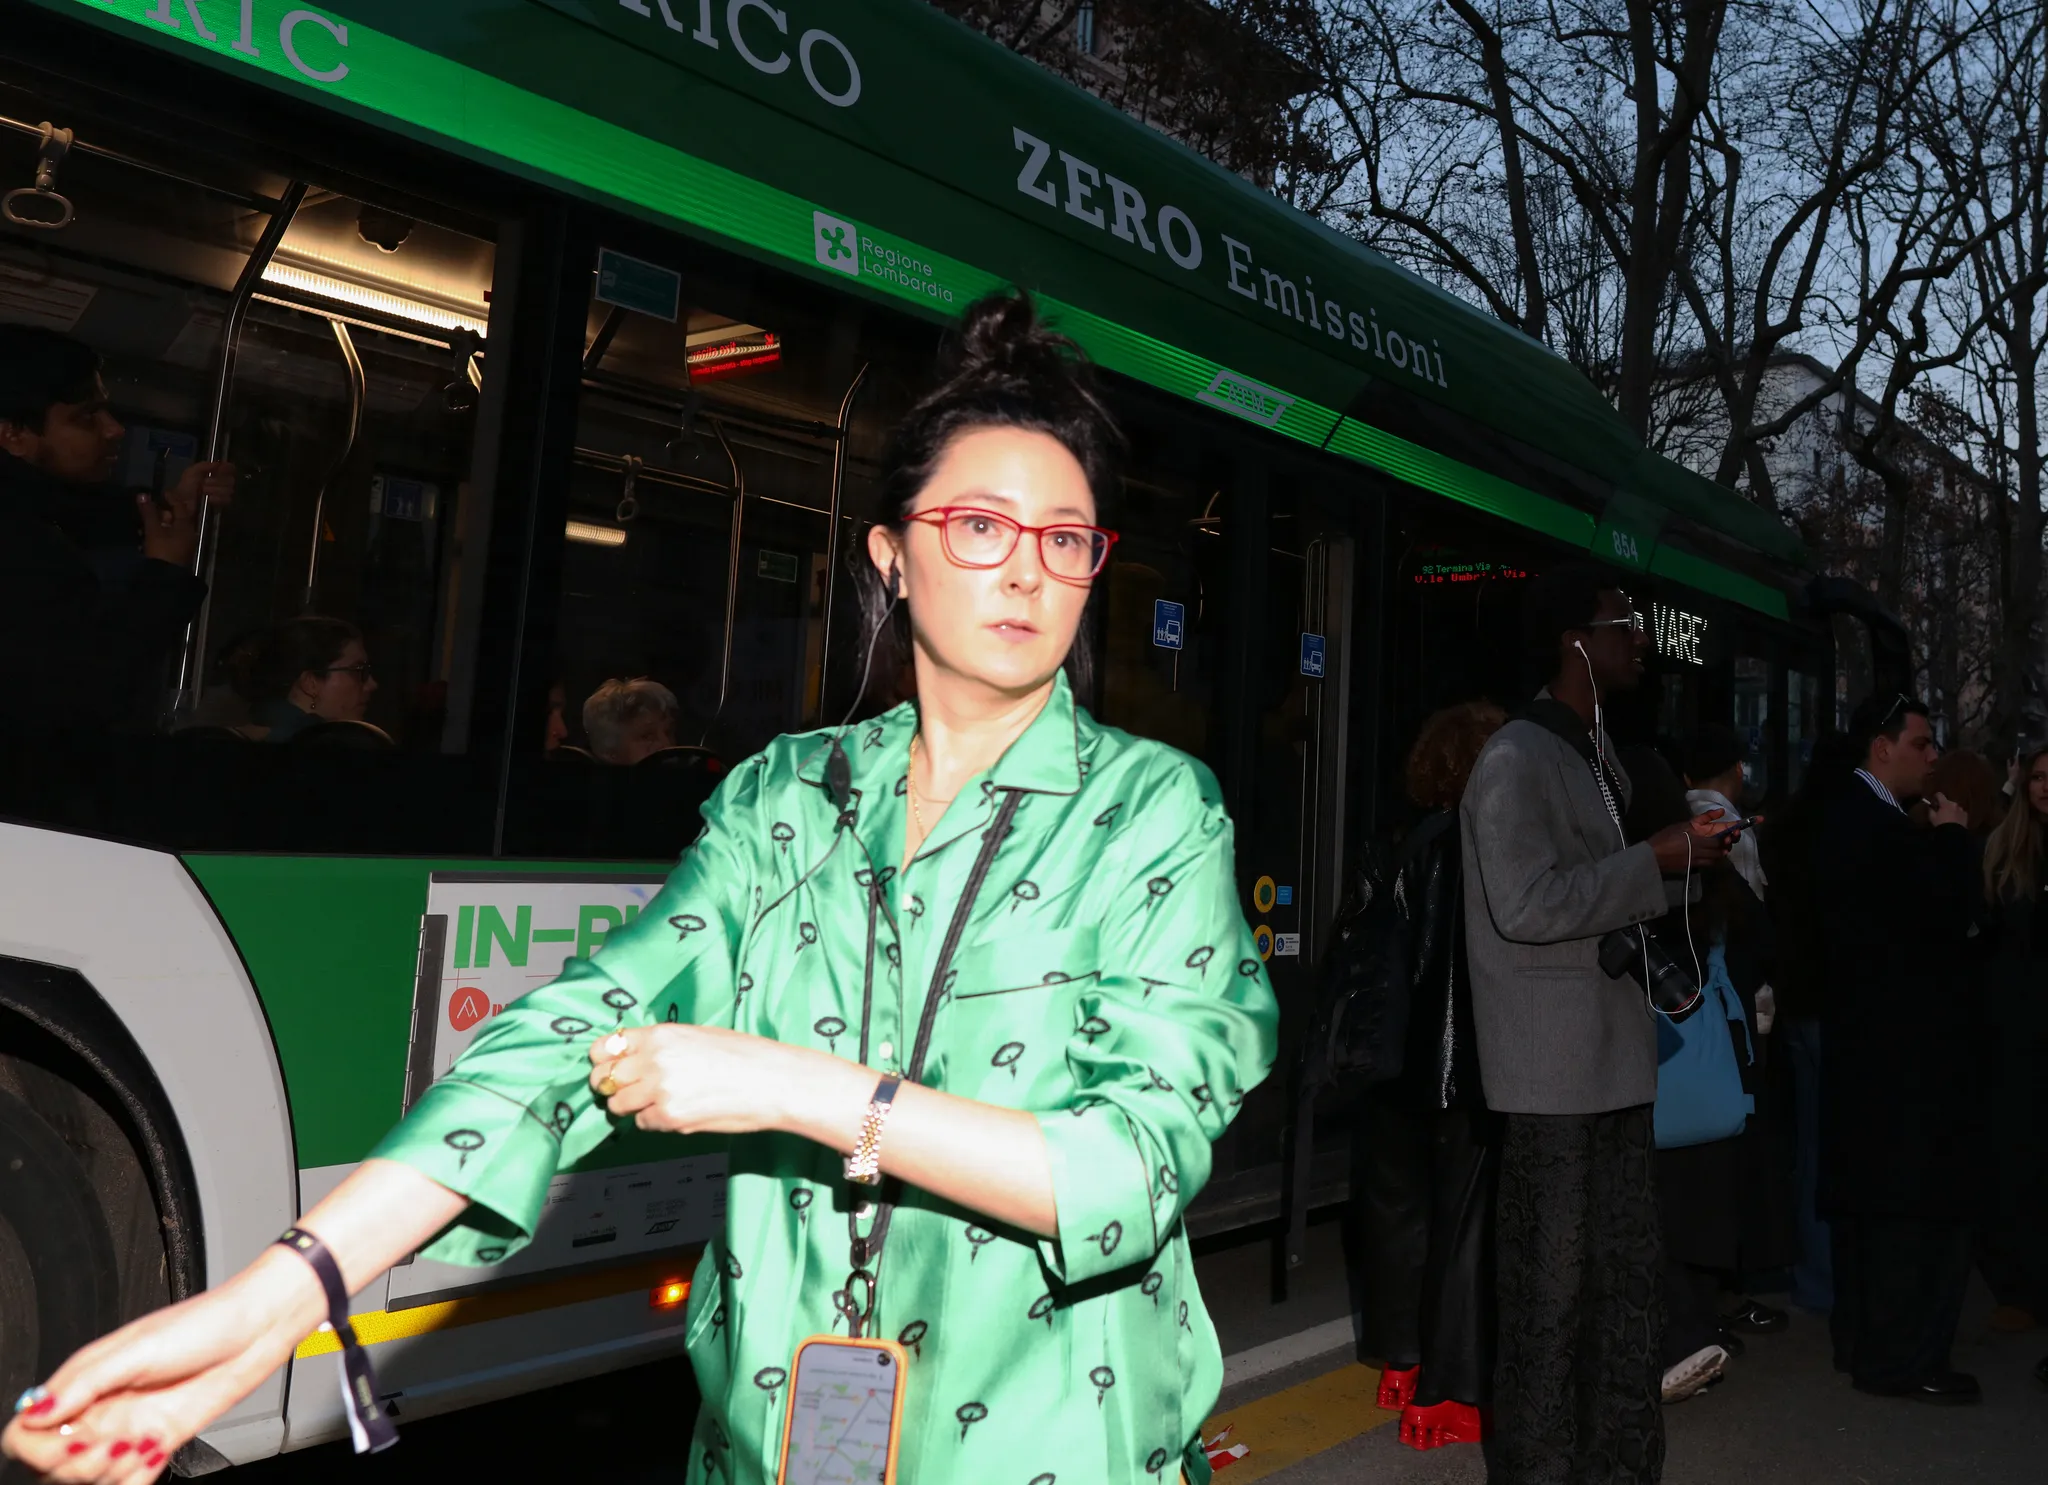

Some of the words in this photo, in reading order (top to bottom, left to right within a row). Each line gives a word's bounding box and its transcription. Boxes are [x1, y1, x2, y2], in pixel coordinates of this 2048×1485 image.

[861, 236, 933, 277] Regione
[1012, 126, 1203, 271] ZERO
[1221, 233, 1448, 389] Emissioni
[863, 256, 953, 302] Lombardia
[1228, 384, 1266, 414] ATM
[1613, 530, 1639, 562] 854
[1422, 565, 1434, 574] 92
[1436, 564, 1473, 573] Termina
[1475, 561, 1491, 571] Via
[1503, 569, 1526, 579] Via
